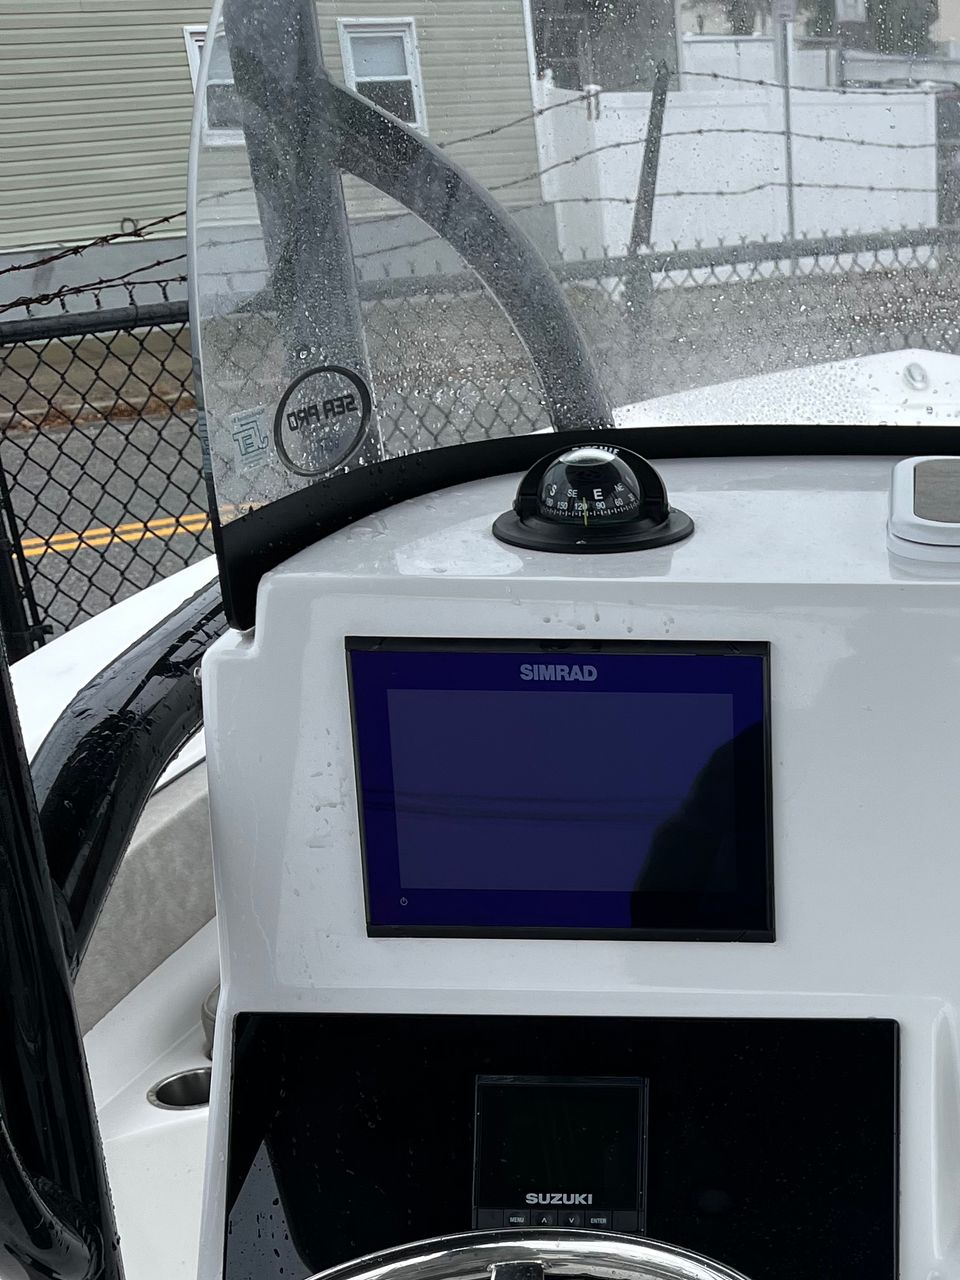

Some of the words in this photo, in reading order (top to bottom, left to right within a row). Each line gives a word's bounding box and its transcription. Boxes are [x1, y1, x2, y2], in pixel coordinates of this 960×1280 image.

[567, 489, 578, 498] SE
[593, 489, 603, 500] E
[595, 501, 606, 510] 90
[520, 664, 598, 681] SIMRAD
[525, 1193, 593, 1205] SUZUKI
